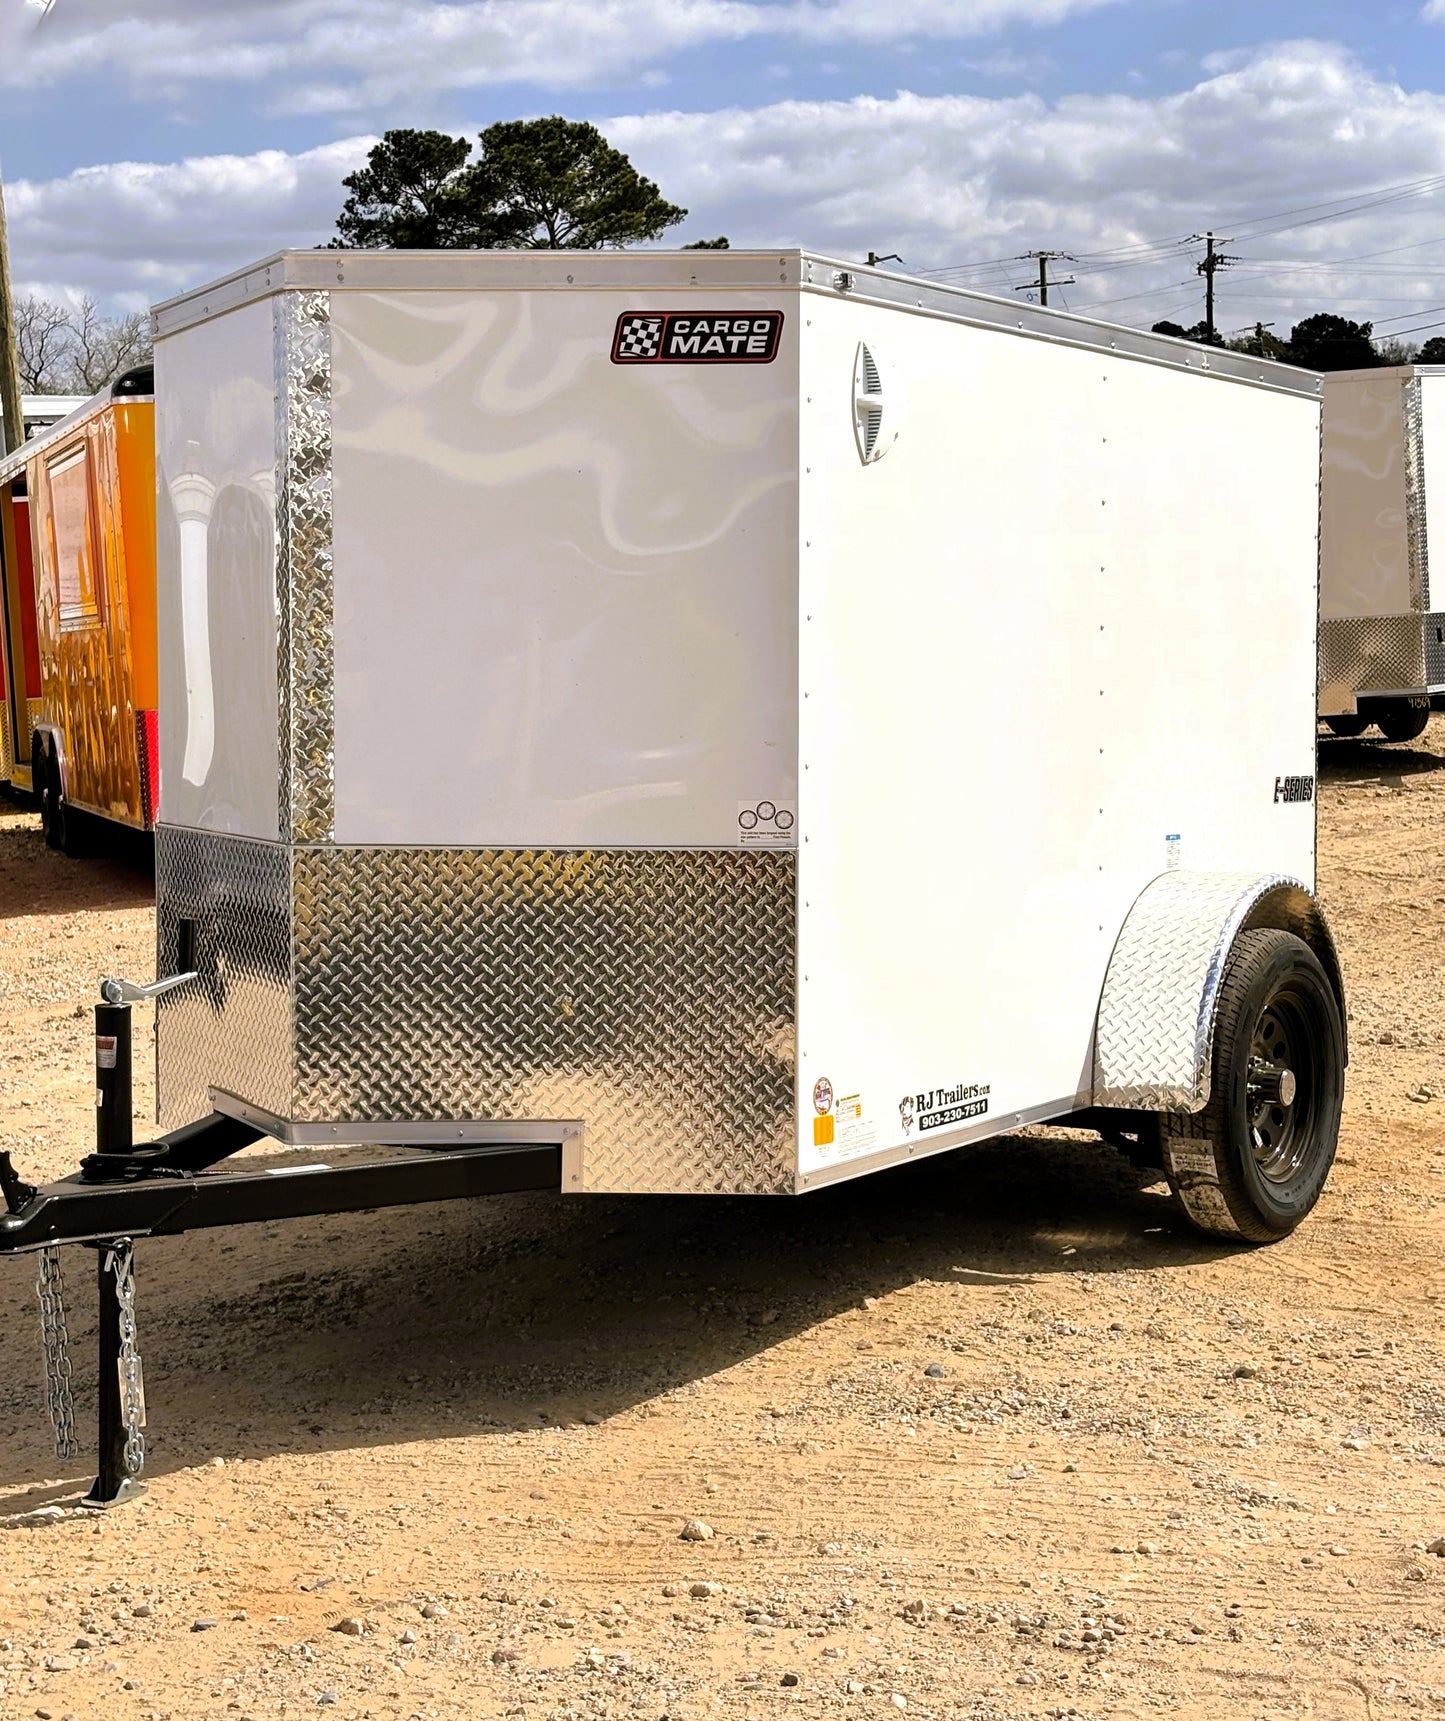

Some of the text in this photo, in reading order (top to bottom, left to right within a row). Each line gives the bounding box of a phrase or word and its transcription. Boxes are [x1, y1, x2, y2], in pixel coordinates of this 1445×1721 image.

[673, 320, 770, 333] CARGO
[669, 335, 768, 354] MATE
[1273, 775, 1313, 804] E-SERIES
[916, 1091, 934, 1113] RJ
[922, 1100, 986, 1128] 903-230-7511
